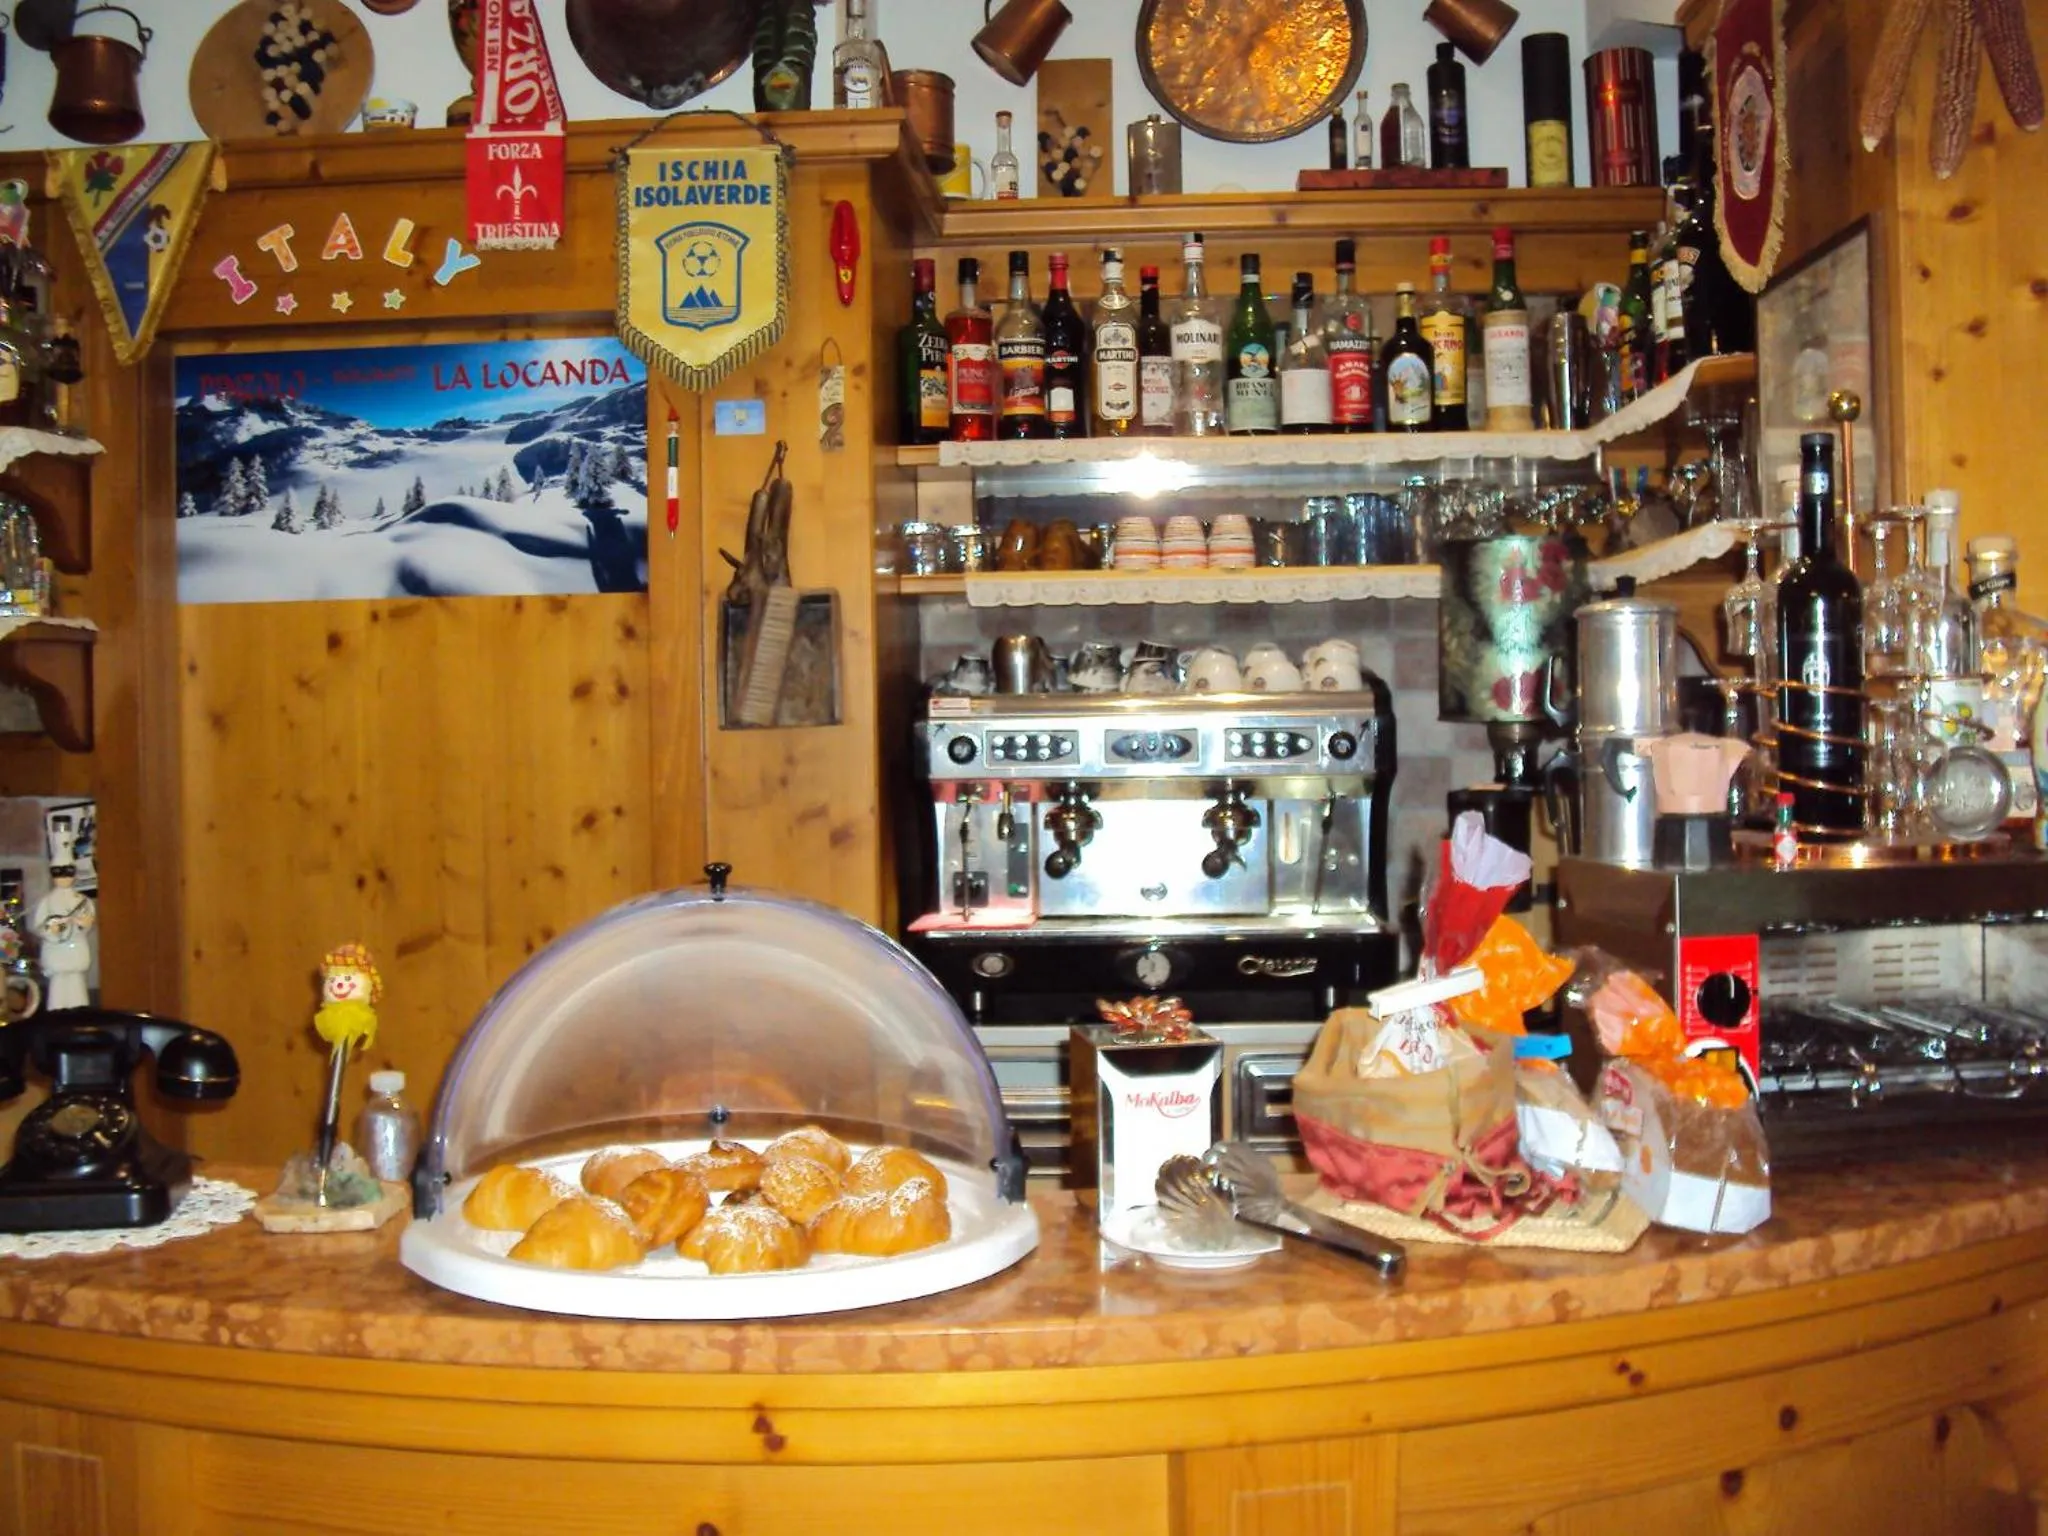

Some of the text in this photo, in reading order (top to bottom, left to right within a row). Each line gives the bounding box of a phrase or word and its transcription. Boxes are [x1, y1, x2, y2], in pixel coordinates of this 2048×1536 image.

[503, 0, 542, 123] ORZA
[487, 142, 543, 160] FORZA
[658, 159, 748, 182] ISCHIA
[634, 184, 772, 207] ISOLAVERDE
[474, 220, 561, 241] TRIESTINA
[213, 212, 481, 304] ITALY
[1045, 355, 1079, 364] MARTINI
[1099, 349, 1135, 361] MARTINI
[432, 361, 472, 392] LA
[482, 356, 631, 390] LOCANDA
